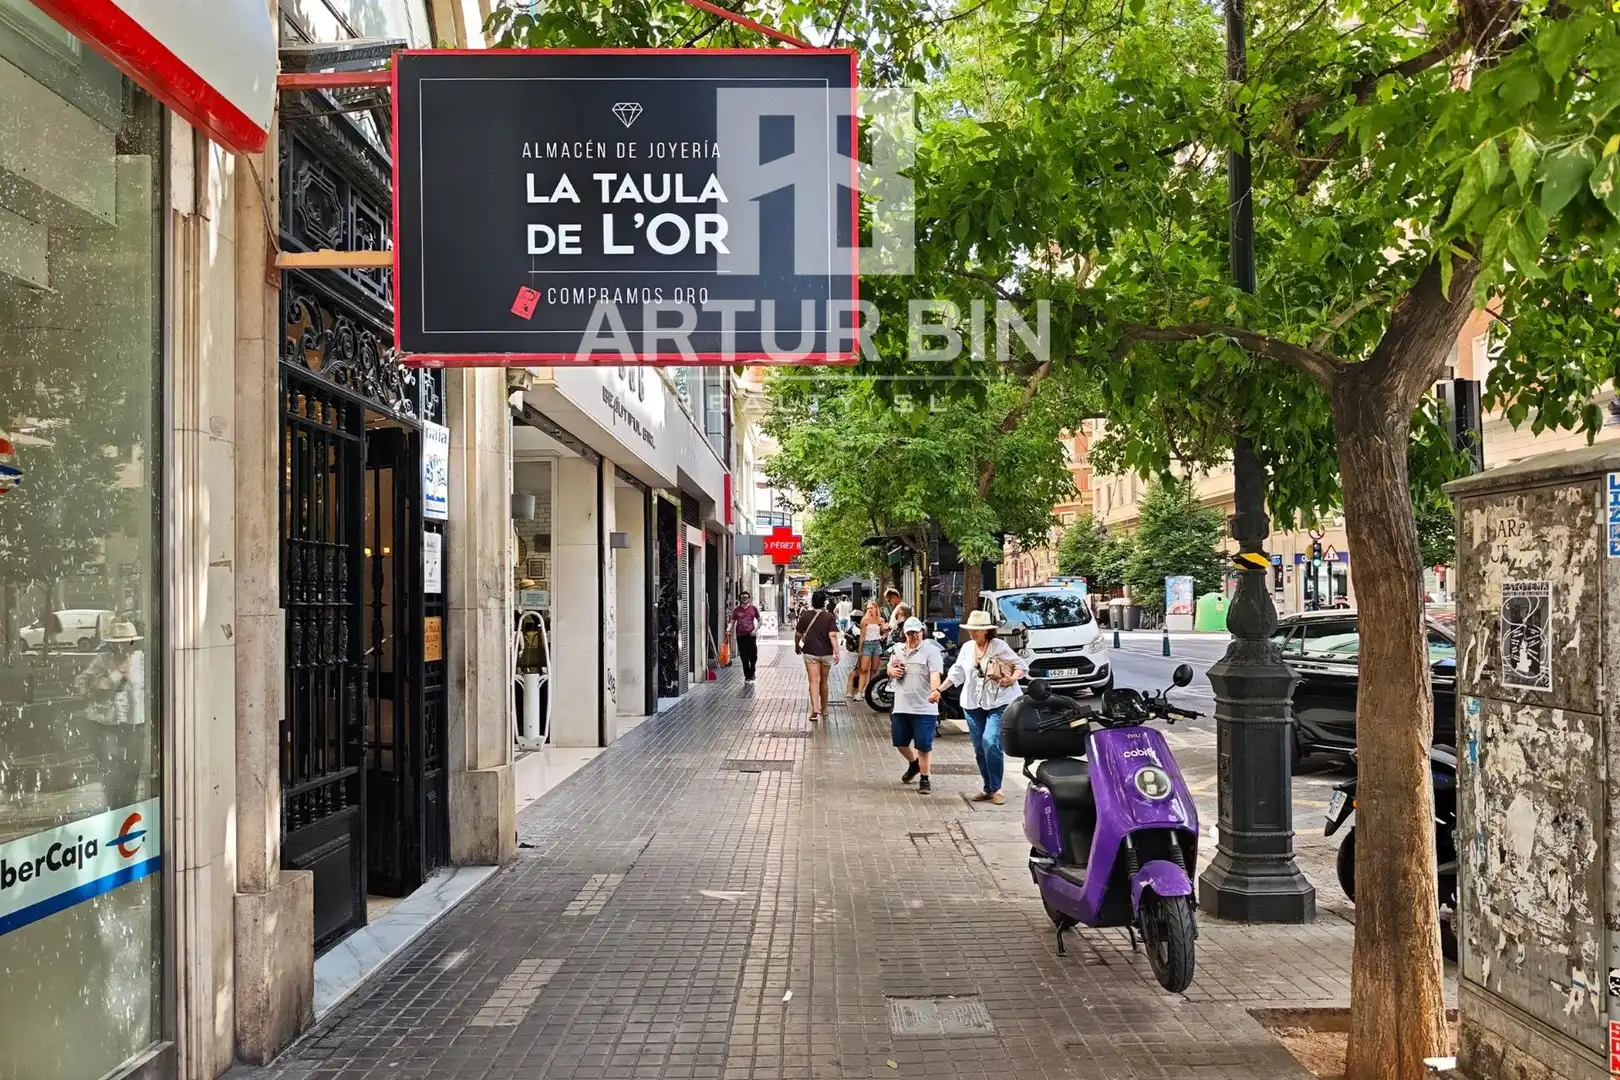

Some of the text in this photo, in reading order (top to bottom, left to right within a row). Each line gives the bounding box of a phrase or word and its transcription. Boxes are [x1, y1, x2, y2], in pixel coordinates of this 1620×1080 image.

[522, 139, 721, 159] ALMACÉN DE JOYERÍA
[526, 173, 729, 204] LA TAULA
[527, 223, 583, 255] DE
[547, 287, 709, 305] COMPRAMOS ORO
